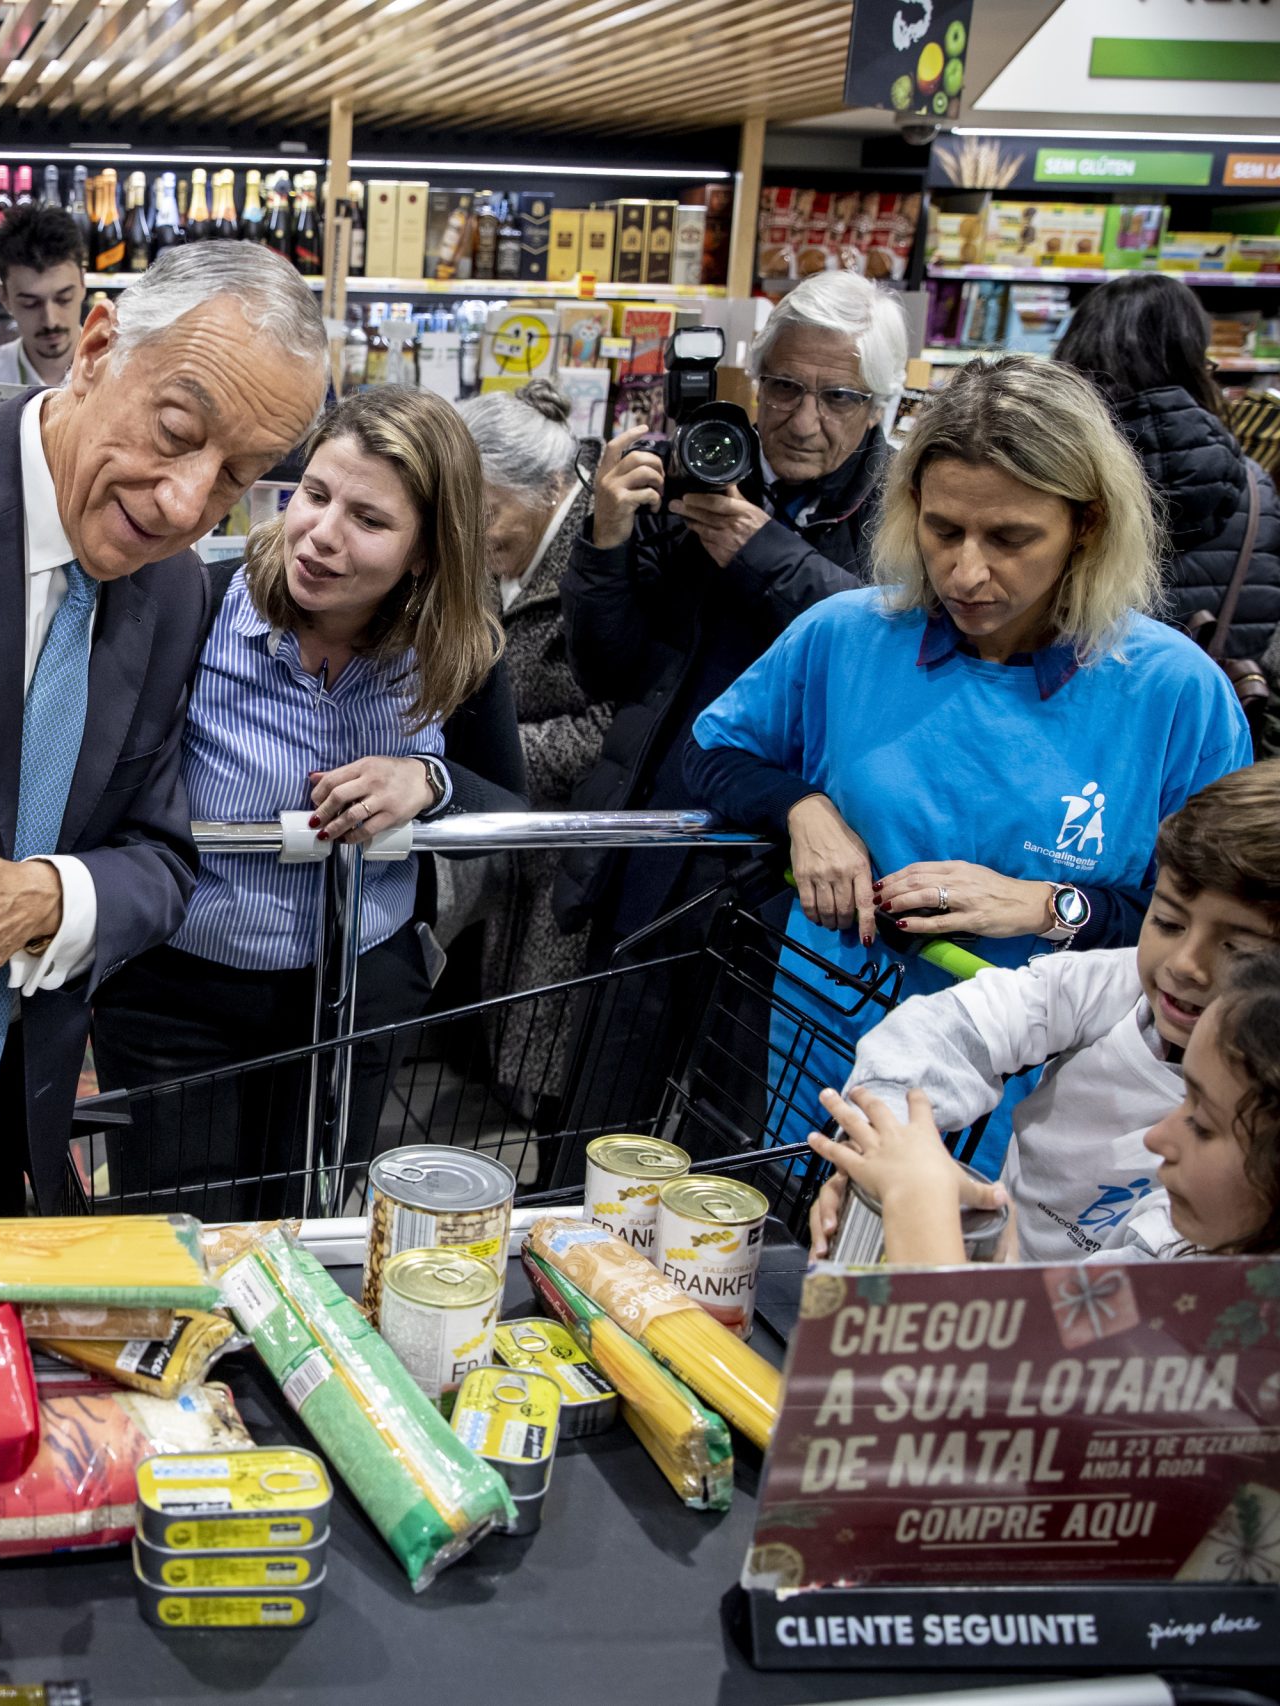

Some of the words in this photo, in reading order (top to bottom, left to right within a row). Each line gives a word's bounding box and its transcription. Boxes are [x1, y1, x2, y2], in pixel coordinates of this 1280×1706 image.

[1044, 157, 1076, 175] SEM
[1078, 155, 1136, 176] GLÚTEN
[1233, 162, 1265, 180] SEM
[830, 1299, 1026, 1357] CHEGOU
[814, 1369, 855, 1427] A
[874, 1362, 990, 1423] SUA
[1005, 1354, 1238, 1419] LOTARIA
[800, 1436, 876, 1494] DE
[887, 1429, 1064, 1488] NATAL
[1085, 1439, 1117, 1457] DIA
[1123, 1438, 1150, 1457] 23
[1154, 1437, 1180, 1456] DE
[1183, 1434, 1280, 1455] DEZEMBRO
[1079, 1461, 1132, 1480] ANDA
[1155, 1459, 1206, 1478] RODA
[895, 1504, 1053, 1543] COMPRE
[1061, 1502, 1156, 1541] AQUI
[776, 1615, 915, 1646] CLIENTE
[922, 1614, 1099, 1647] SEGUINTE
[1146, 1618, 1208, 1651] pingo
[1211, 1613, 1262, 1635] doce
